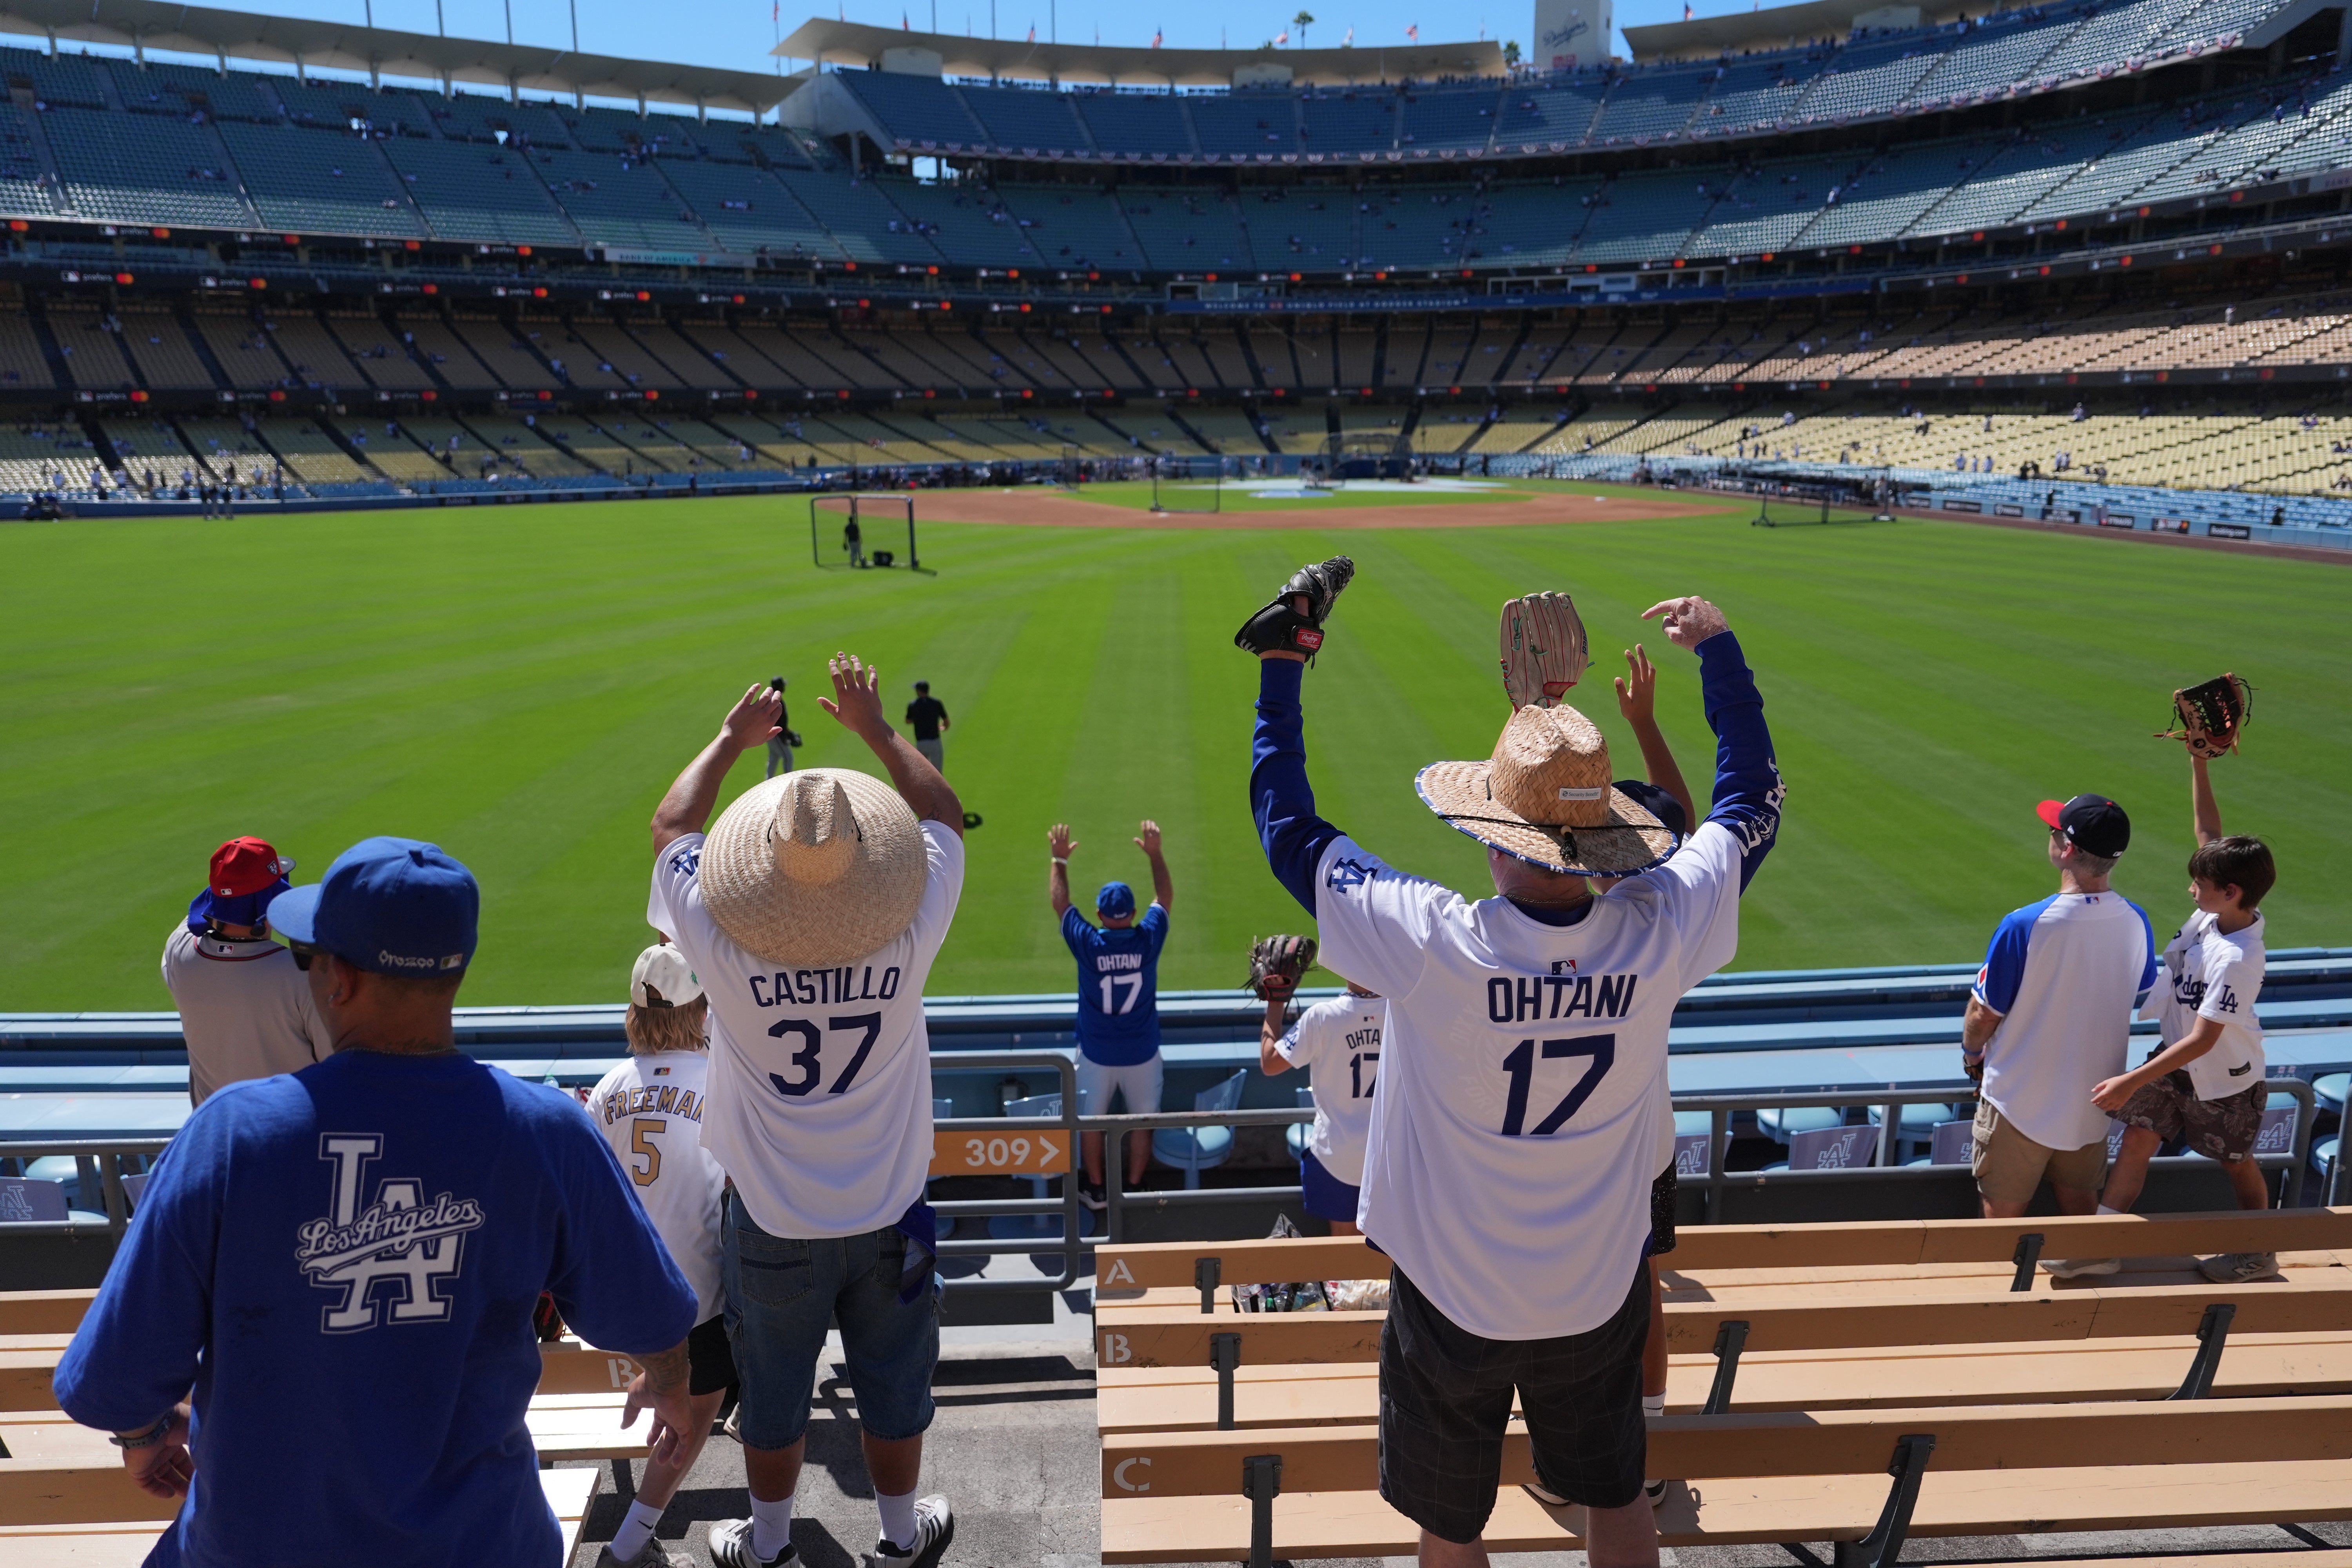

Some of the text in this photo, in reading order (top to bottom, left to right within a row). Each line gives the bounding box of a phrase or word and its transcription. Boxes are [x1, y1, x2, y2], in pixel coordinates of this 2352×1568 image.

[1301, 634, 1318, 643] Rawlings
[1327, 857, 1377, 893] LA
[1097, 954, 1142, 972] OHTANI
[750, 966, 900, 1007] CASTILLO
[1099, 971, 1143, 1016] 17
[1487, 975, 1637, 1023] OHTANI
[2219, 984, 2238, 1013] LA
[768, 1011, 881, 1096] 37
[1346, 1029, 1381, 1049] OHTA
[1350, 1053, 1380, 1098] 17
[1501, 1033, 1615, 1136] 17
[632, 1118, 666, 1187] 5
[965, 1137, 1031, 1167] 309
[297, 1194, 481, 1257] Los Angeles
[312, 1134, 465, 1333] LA
[1104, 1259, 1135, 1284] A
[1105, 1334, 1132, 1363] B
[608, 1359, 638, 1388] B
[1113, 1457, 1151, 1492] C
